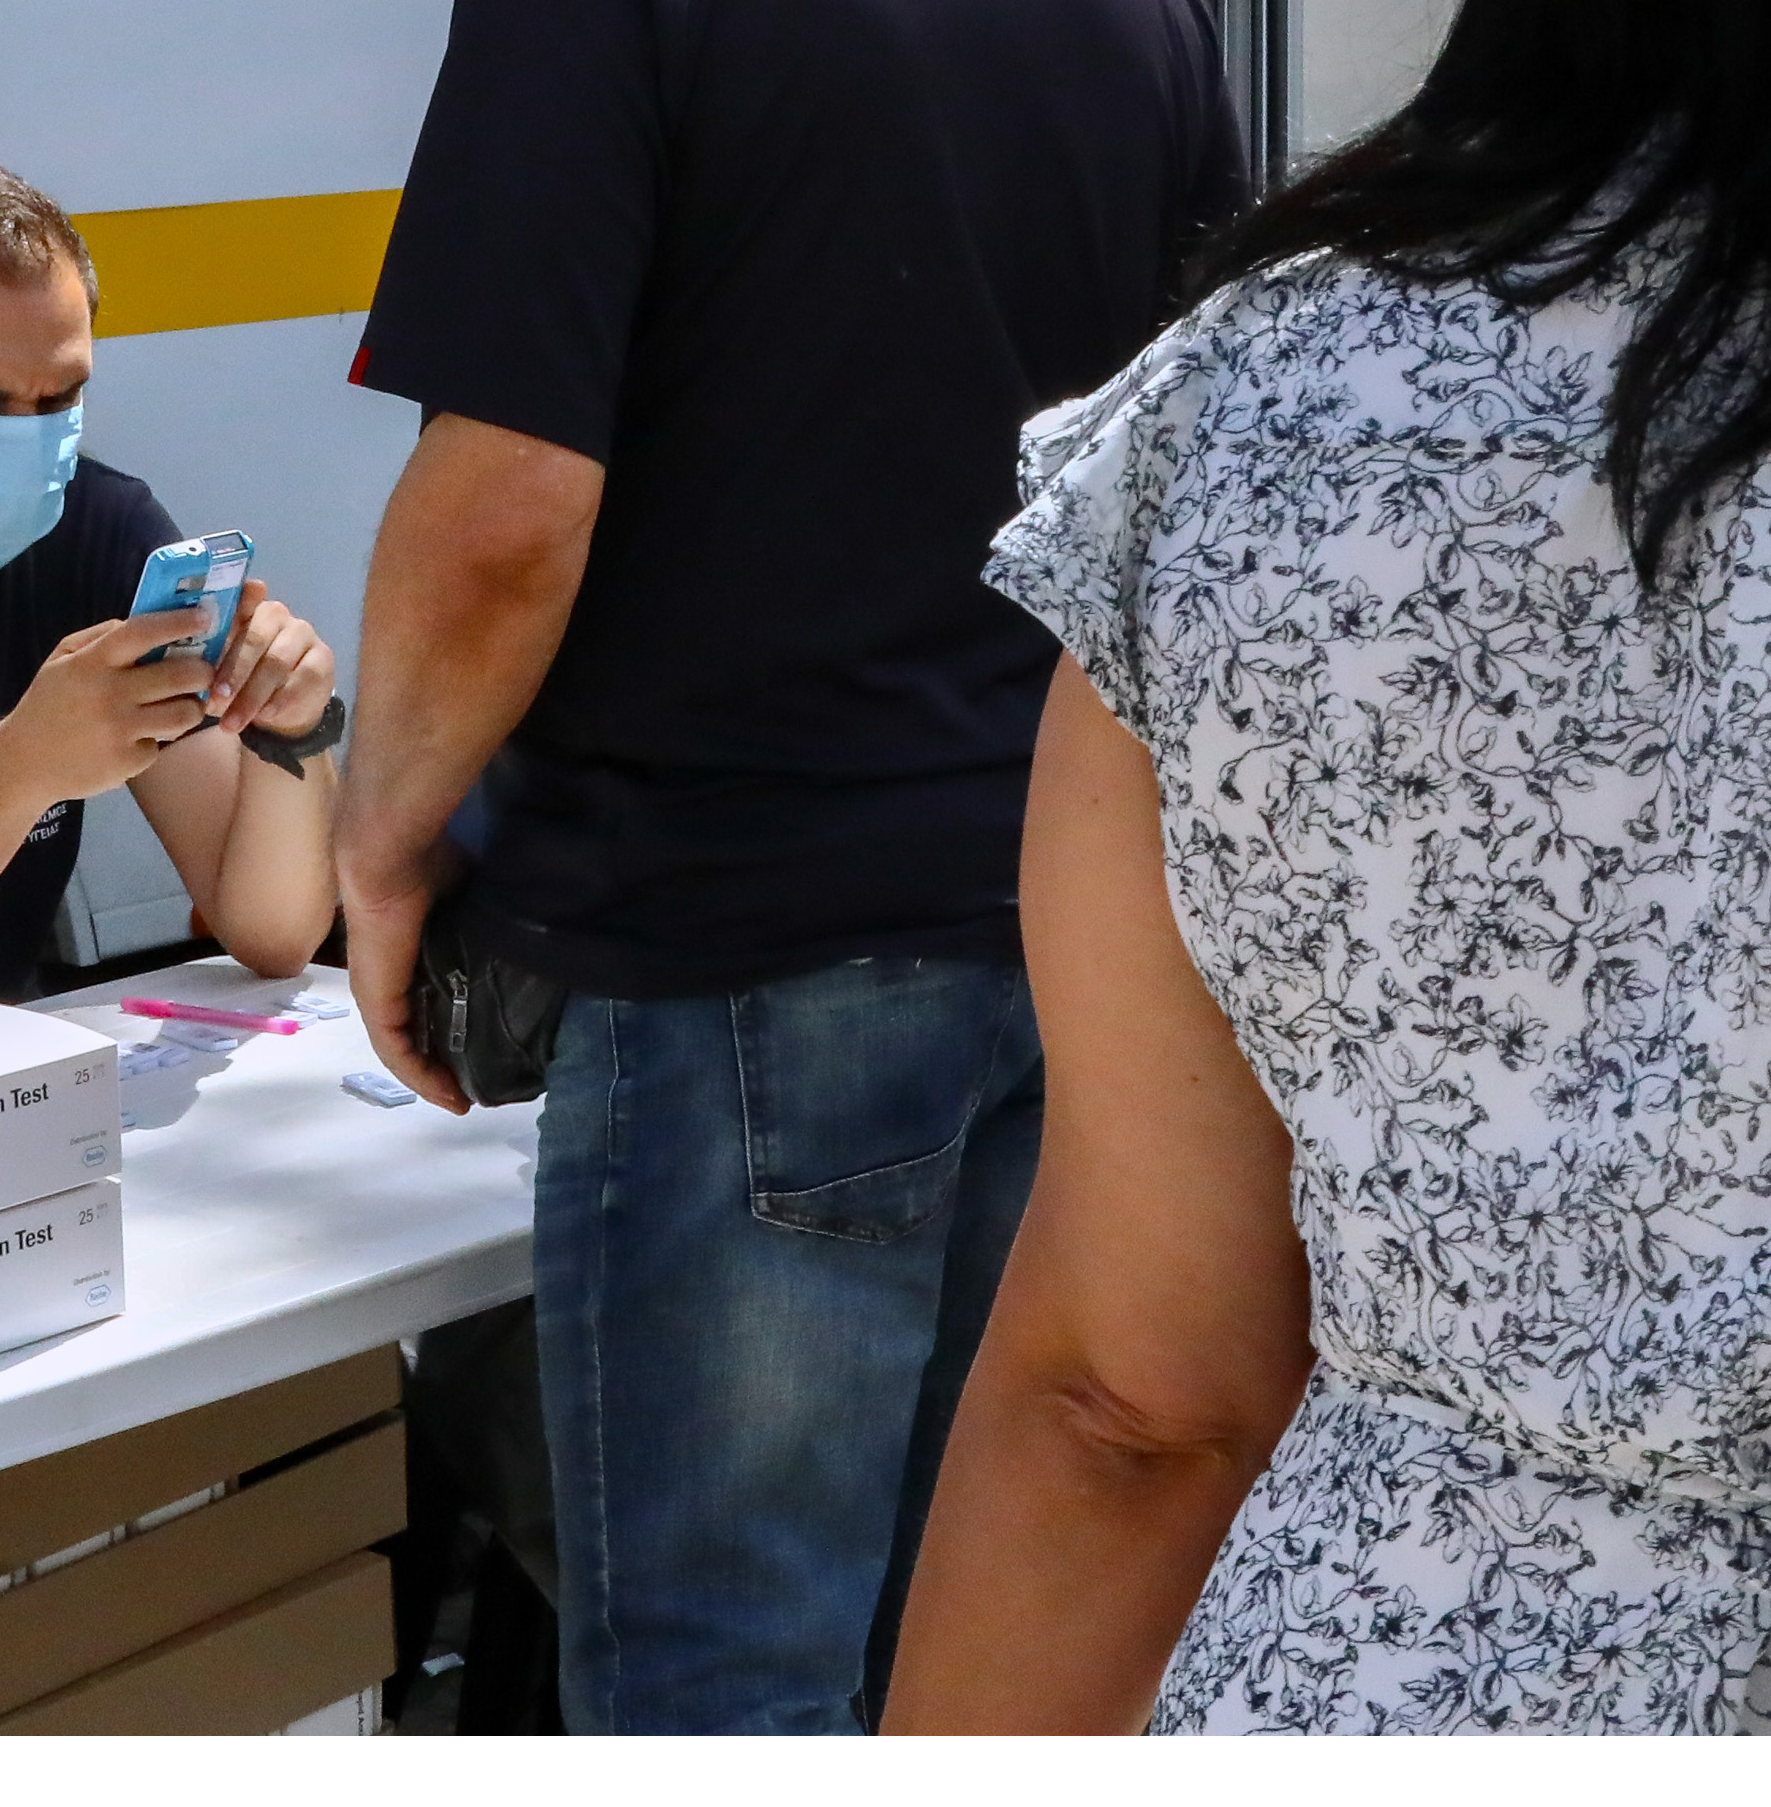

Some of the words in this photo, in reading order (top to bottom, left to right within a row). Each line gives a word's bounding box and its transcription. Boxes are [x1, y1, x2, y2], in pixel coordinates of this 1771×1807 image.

[75, 1069, 90, 1085] 25
[10, 1083, 49, 1109] Test
[78, 1208, 94, 1226] 25
[15, 1224, 54, 1250] Test
